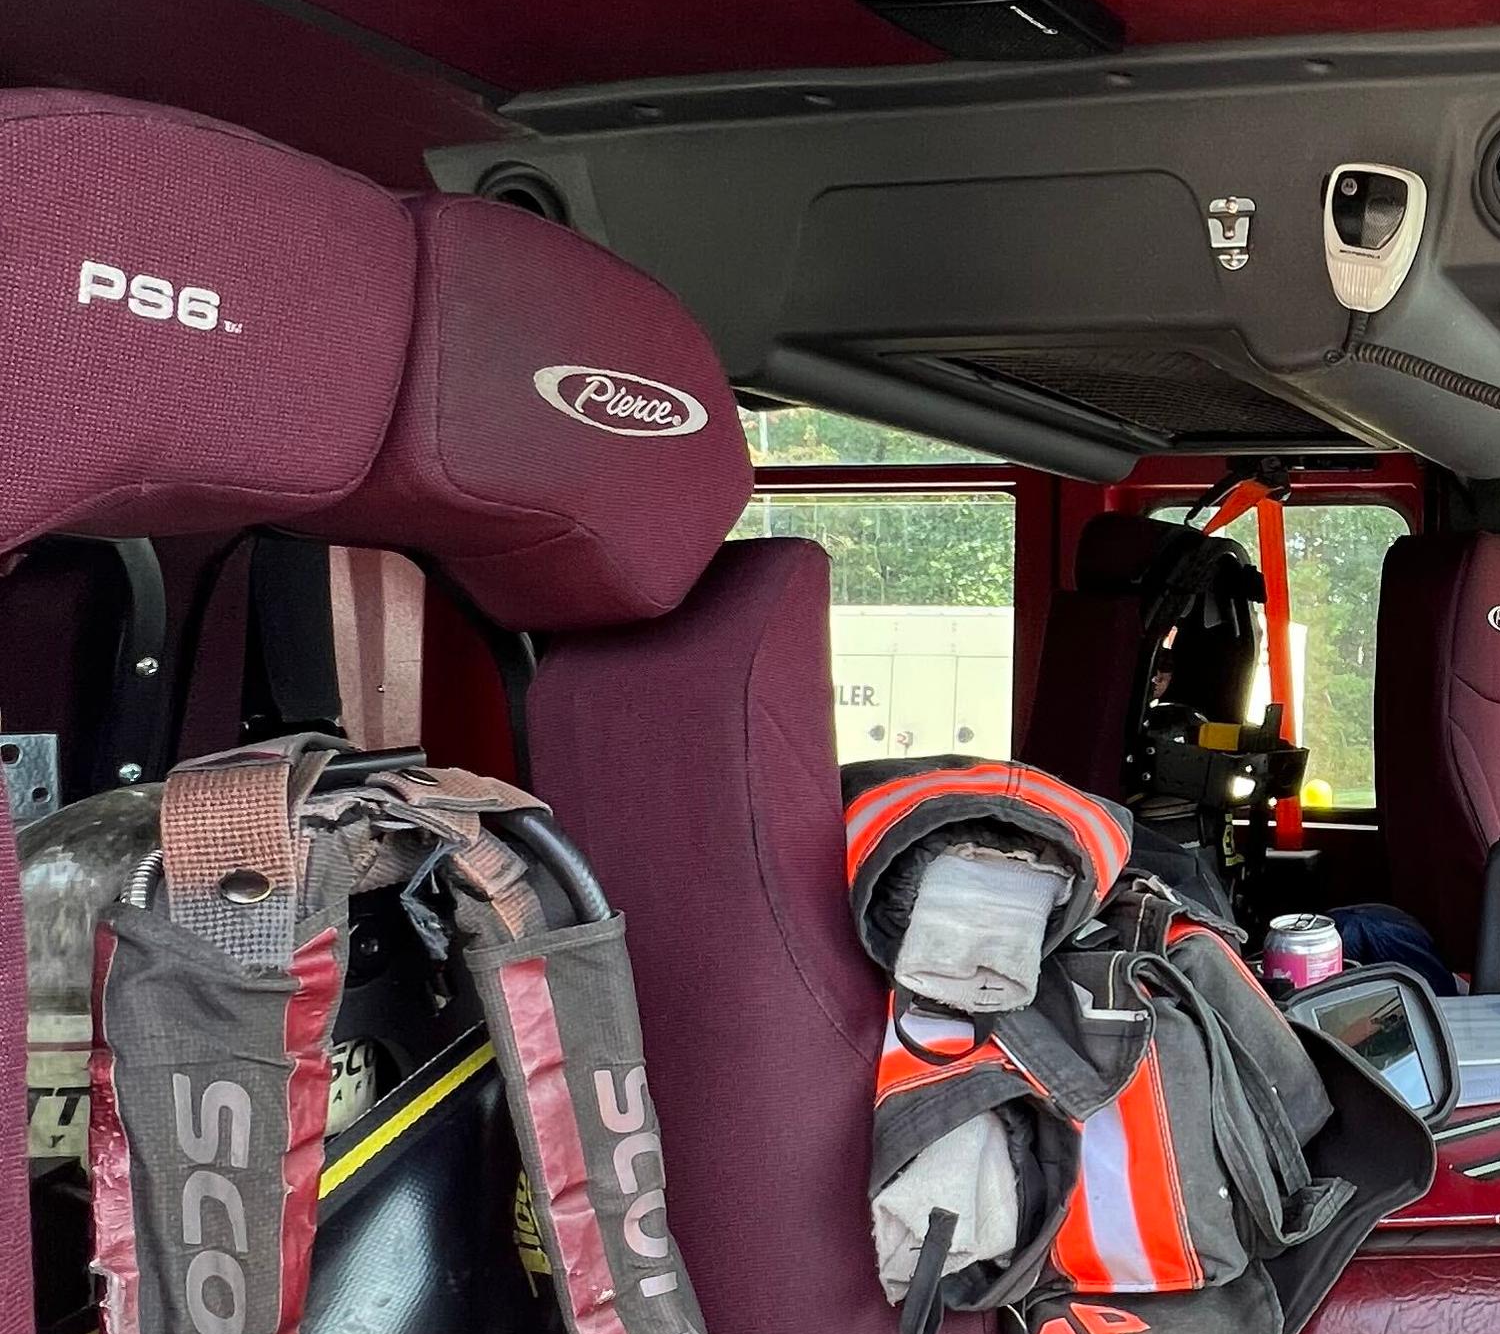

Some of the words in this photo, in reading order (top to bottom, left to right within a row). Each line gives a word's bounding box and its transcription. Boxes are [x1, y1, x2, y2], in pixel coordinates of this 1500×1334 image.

[78, 260, 221, 331] PS6
[574, 375, 673, 425] Pierce
[833, 685, 879, 706] LER
